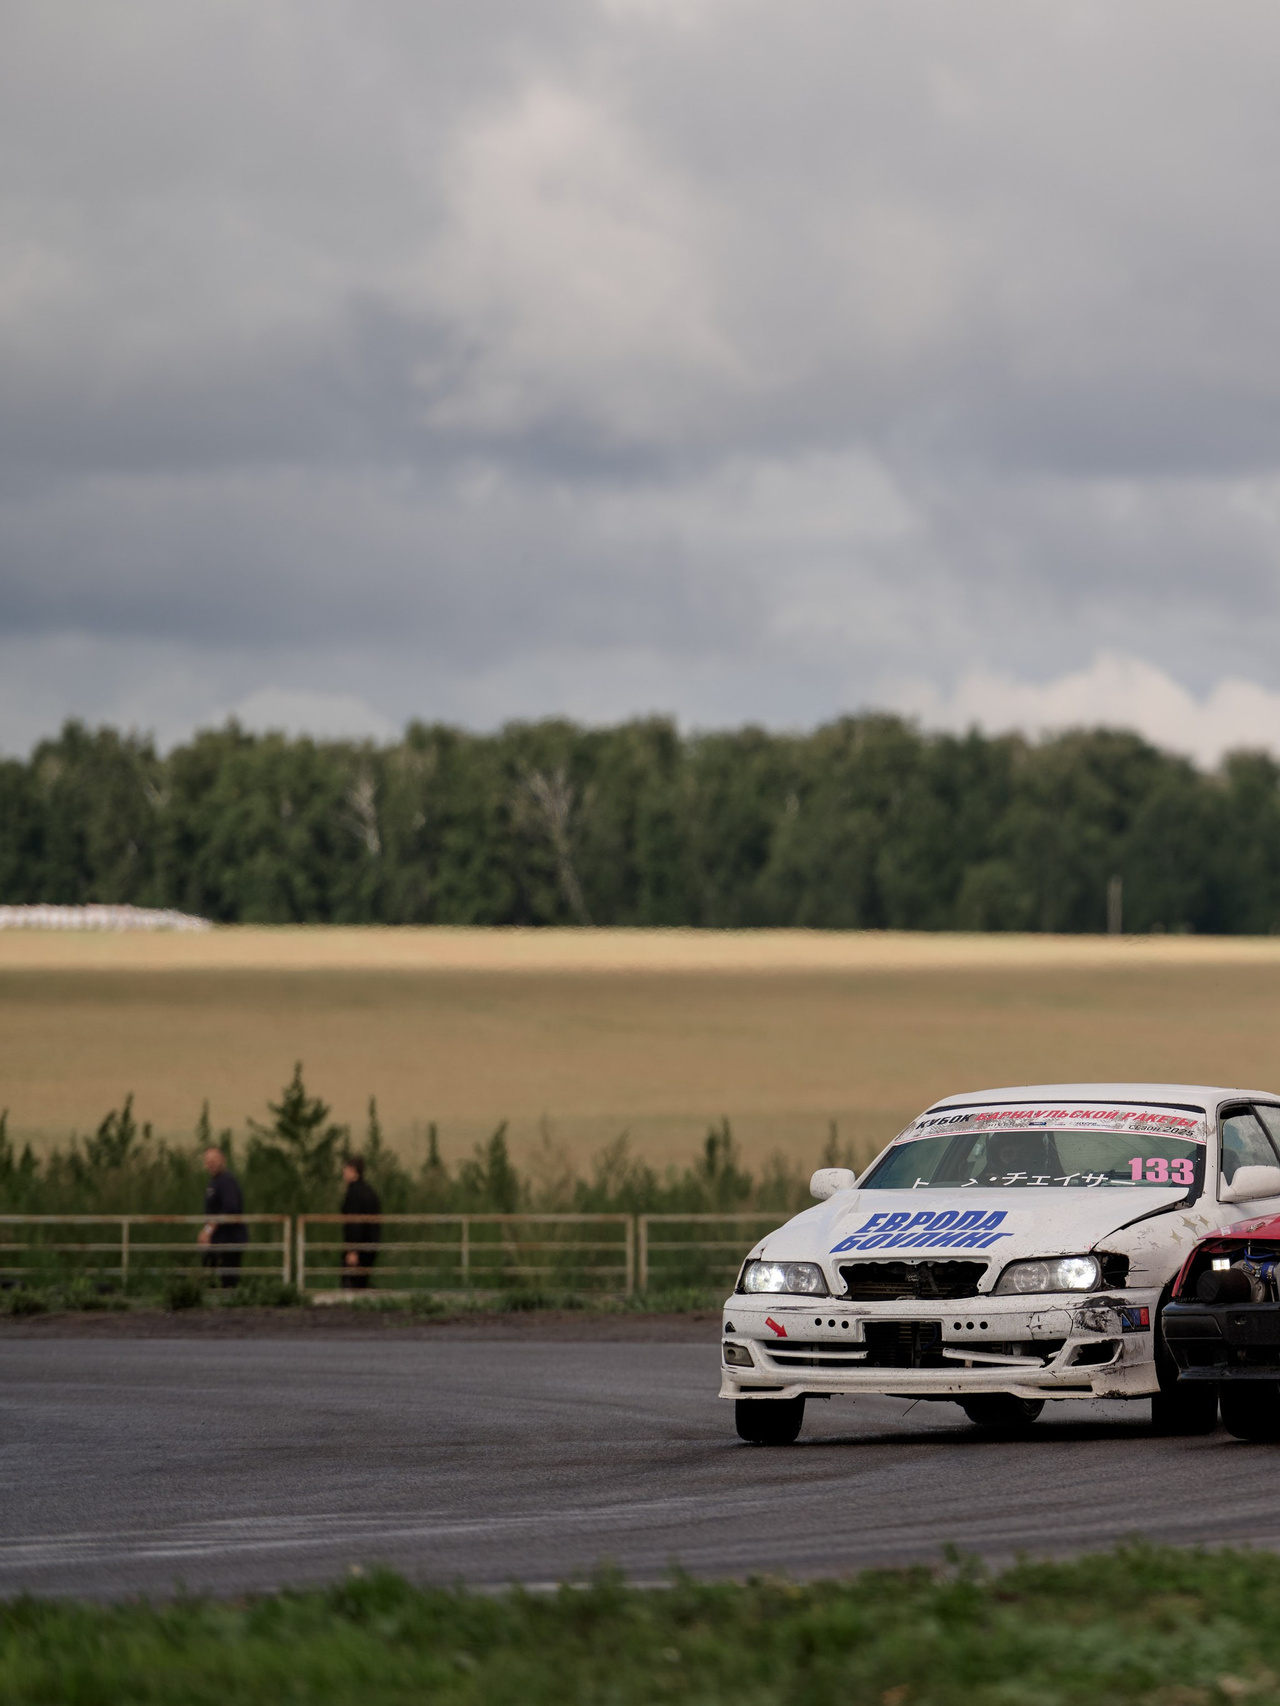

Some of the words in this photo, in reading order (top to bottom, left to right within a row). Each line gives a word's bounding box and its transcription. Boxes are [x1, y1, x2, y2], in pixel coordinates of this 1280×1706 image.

[915, 1113, 976, 1130] КУБОК
[974, 1110, 1121, 1122] БАРНАУЛЬСКОЙ
[1121, 1112, 1199, 1128] РАКЕТЫ
[1128, 1124, 1161, 1133] СЕЗОН
[1128, 1157, 1195, 1185] 133
[853, 1211, 1008, 1234] ЕВРОПА
[829, 1232, 1015, 1255] БОУЛИНГ
